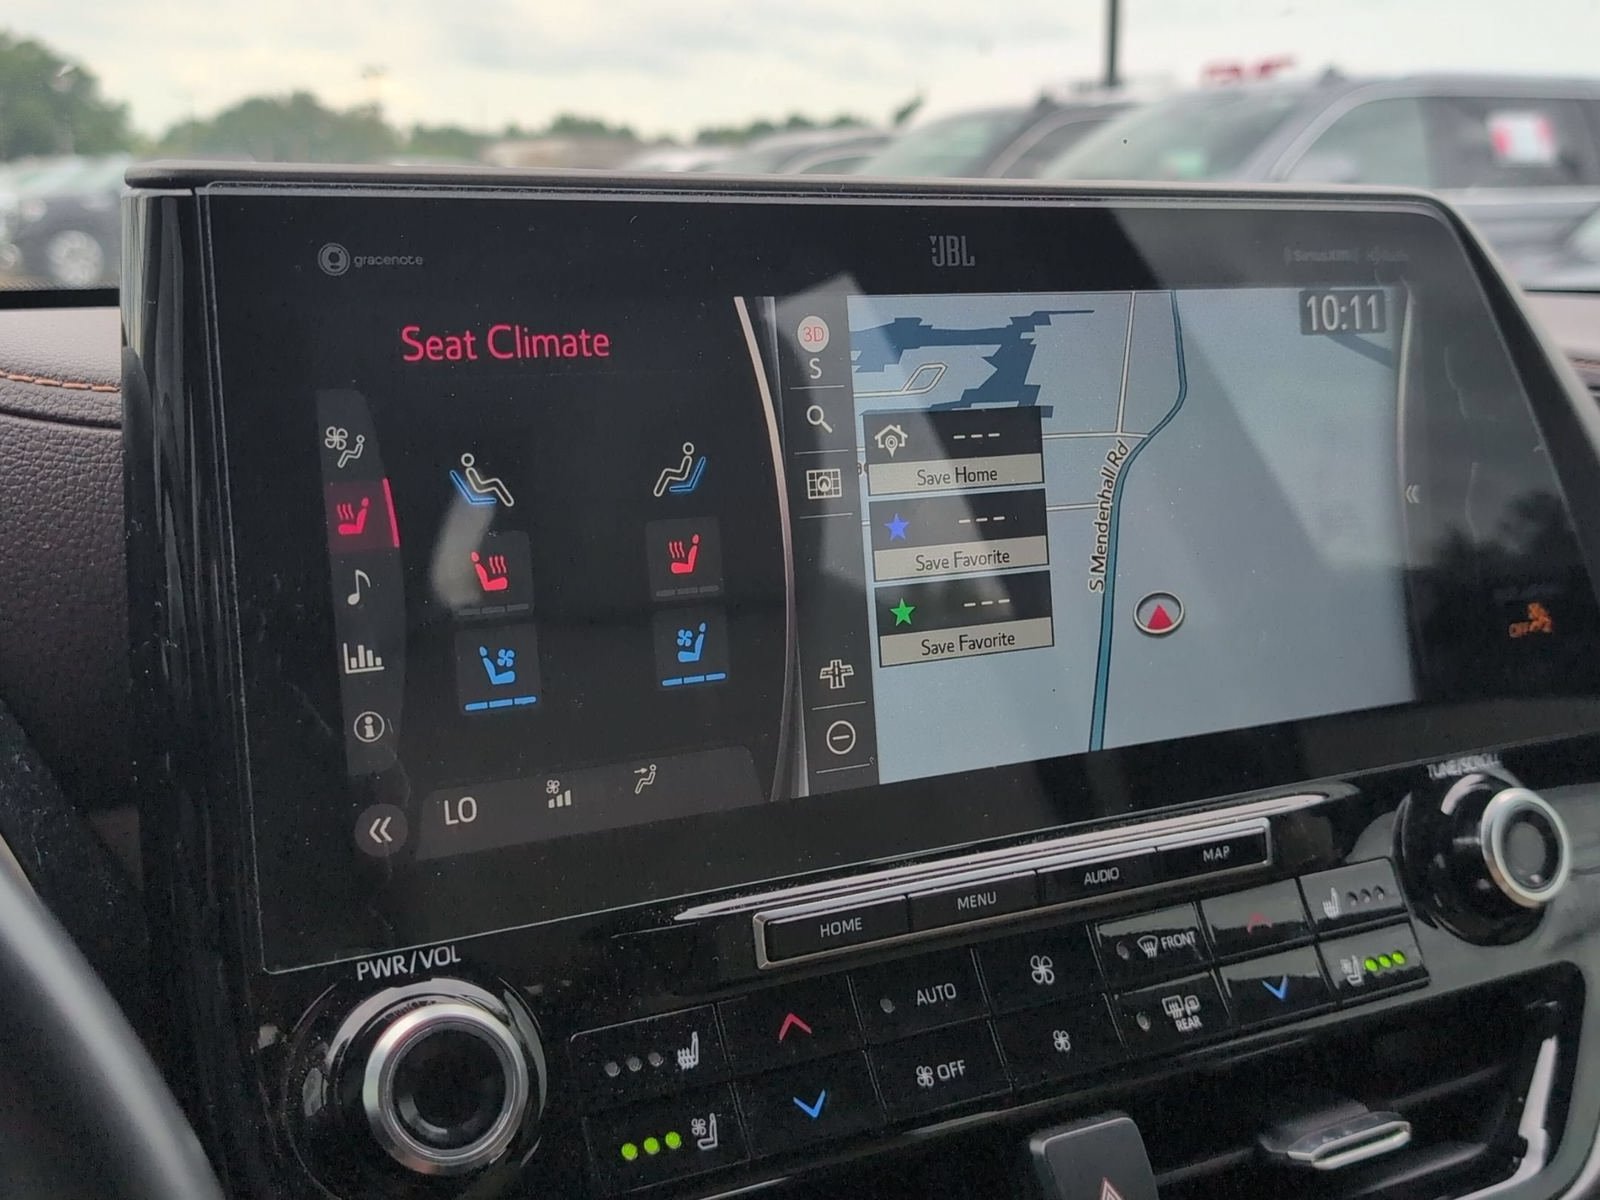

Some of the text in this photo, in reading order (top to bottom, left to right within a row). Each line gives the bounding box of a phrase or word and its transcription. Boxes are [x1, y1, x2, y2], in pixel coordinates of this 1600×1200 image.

[929, 235, 976, 267] JBL
[353, 255, 424, 269] gracenote
[1305, 294, 1381, 332] 10:11
[402, 323, 611, 362] Seat Climate
[801, 325, 825, 343] 3D
[809, 358, 822, 379] S
[917, 466, 998, 487] Save Home
[1089, 439, 1130, 593] S Mendenhall Rd
[915, 549, 1011, 572] Save Favorite
[921, 632, 1016, 656] Save Favorite
[444, 797, 478, 826] LO
[1203, 845, 1231, 861] MAP
[1084, 866, 1120, 886] AUDIO
[957, 890, 998, 910] MENU
[819, 916, 863, 938] HOME
[1161, 932, 1197, 952] FRONT
[356, 945, 462, 981] PWR/VOL
[915, 982, 957, 1007] AUTO
[1176, 1014, 1203, 1032] REAR
[937, 1060, 966, 1081] OFF
